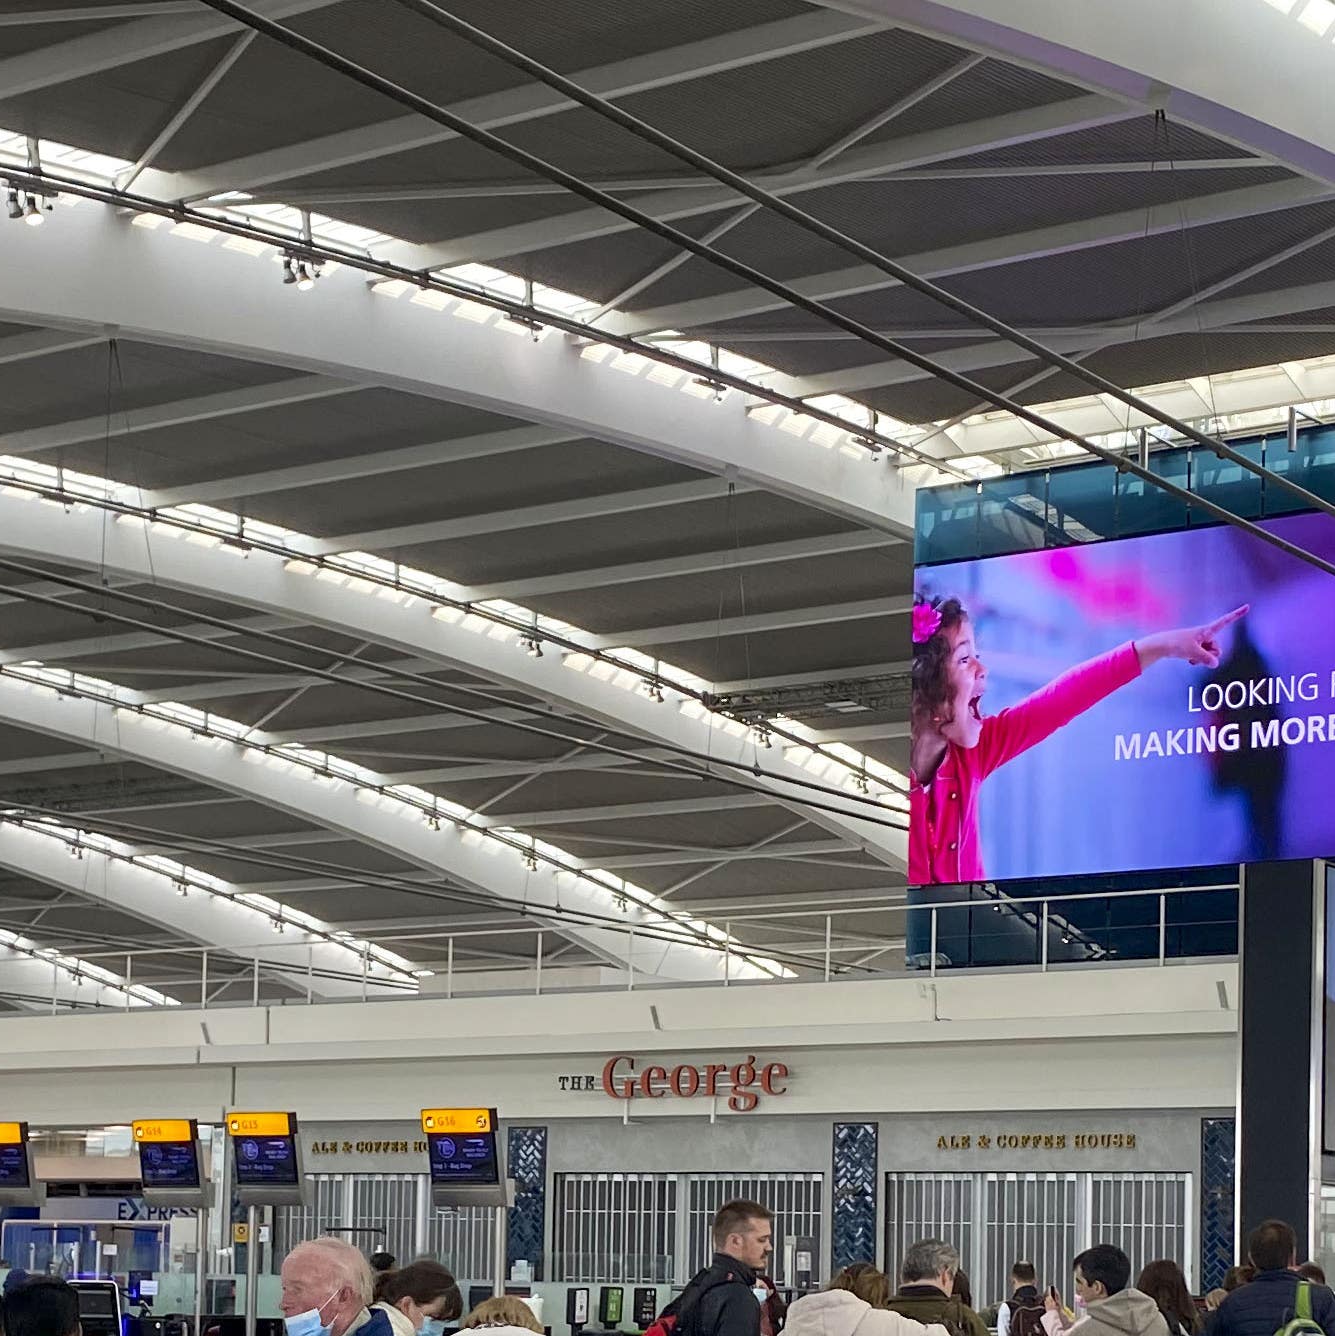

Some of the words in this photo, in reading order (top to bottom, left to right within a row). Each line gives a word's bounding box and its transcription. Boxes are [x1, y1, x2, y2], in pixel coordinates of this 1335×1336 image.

[1187, 671, 1319, 713] LOOKING
[1114, 722, 1241, 761] MAKING
[558, 1075, 595, 1091] THE
[602, 1054, 788, 1112] George
[311, 1141, 338, 1155] ALE
[341, 1141, 353, 1154] &
[356, 1140, 408, 1154] COFFEE
[936, 1134, 971, 1150] ALE
[977, 1133, 991, 1149] &
[996, 1134, 1067, 1150] COFFEE
[1074, 1133, 1137, 1150] HOUSE
